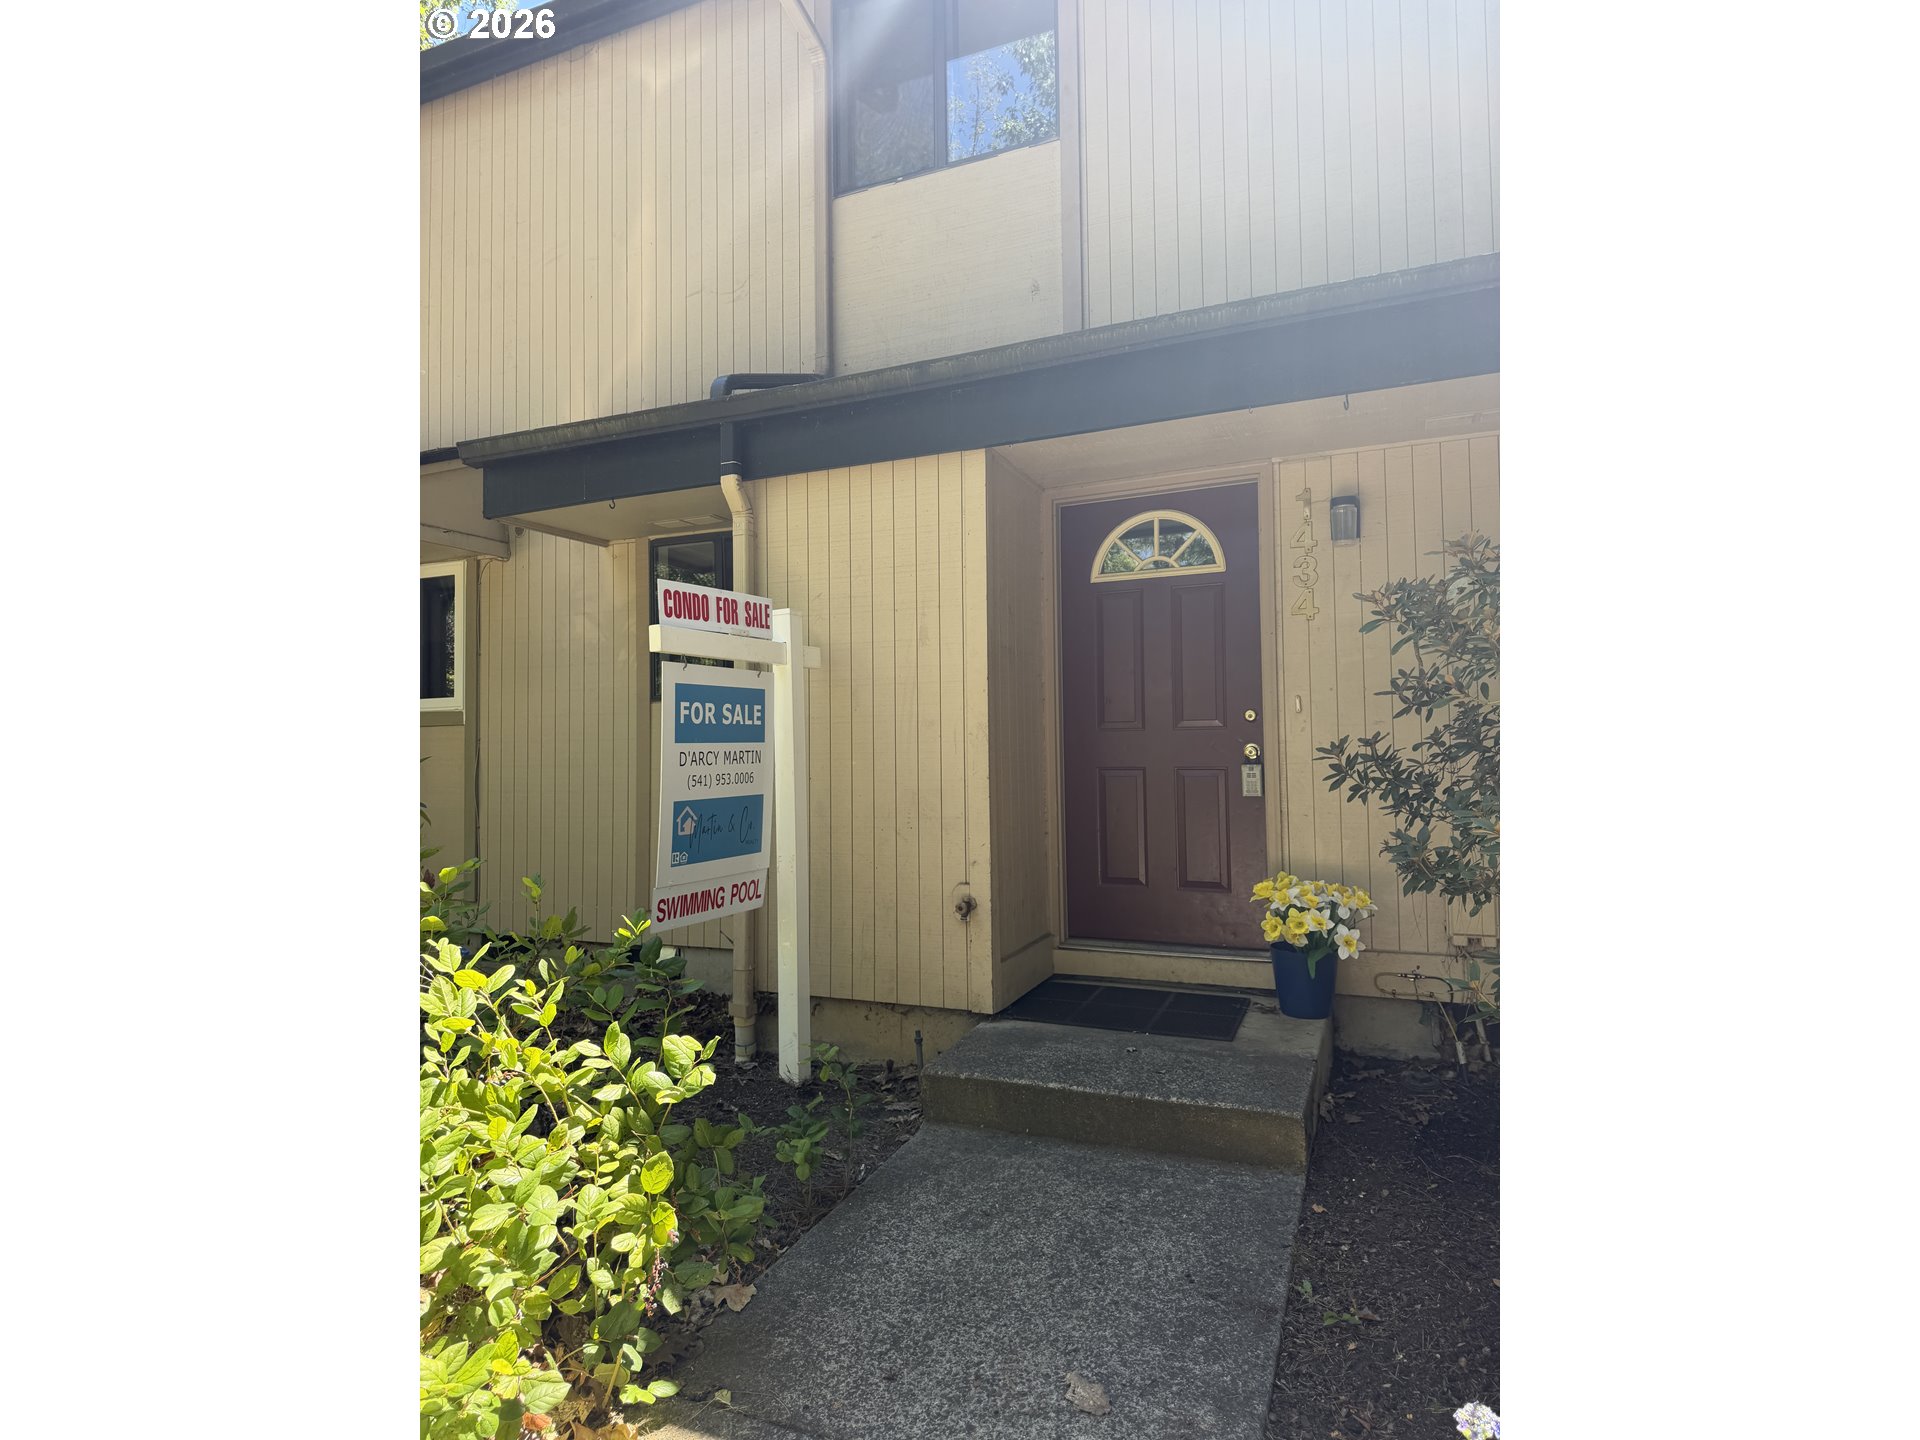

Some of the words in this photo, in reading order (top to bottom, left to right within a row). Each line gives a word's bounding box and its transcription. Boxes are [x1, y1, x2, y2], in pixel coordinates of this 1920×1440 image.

[1290, 487, 1320, 621] 1434
[663, 588, 710, 622] CONDO
[716, 596, 739, 626] FOR
[745, 601, 770, 629] SALE
[680, 701, 716, 724] FOR
[722, 703, 762, 725] SALE
[679, 751, 720, 767] D'ARCY
[723, 750, 762, 765] MARTIN
[687, 773, 713, 790] (541)
[715, 772, 755, 785] 953.0006
[689, 812, 724, 853] Martin
[728, 813, 736, 833] &
[656, 886, 725, 923] SWIMMING
[730, 878, 762, 905] POOL
